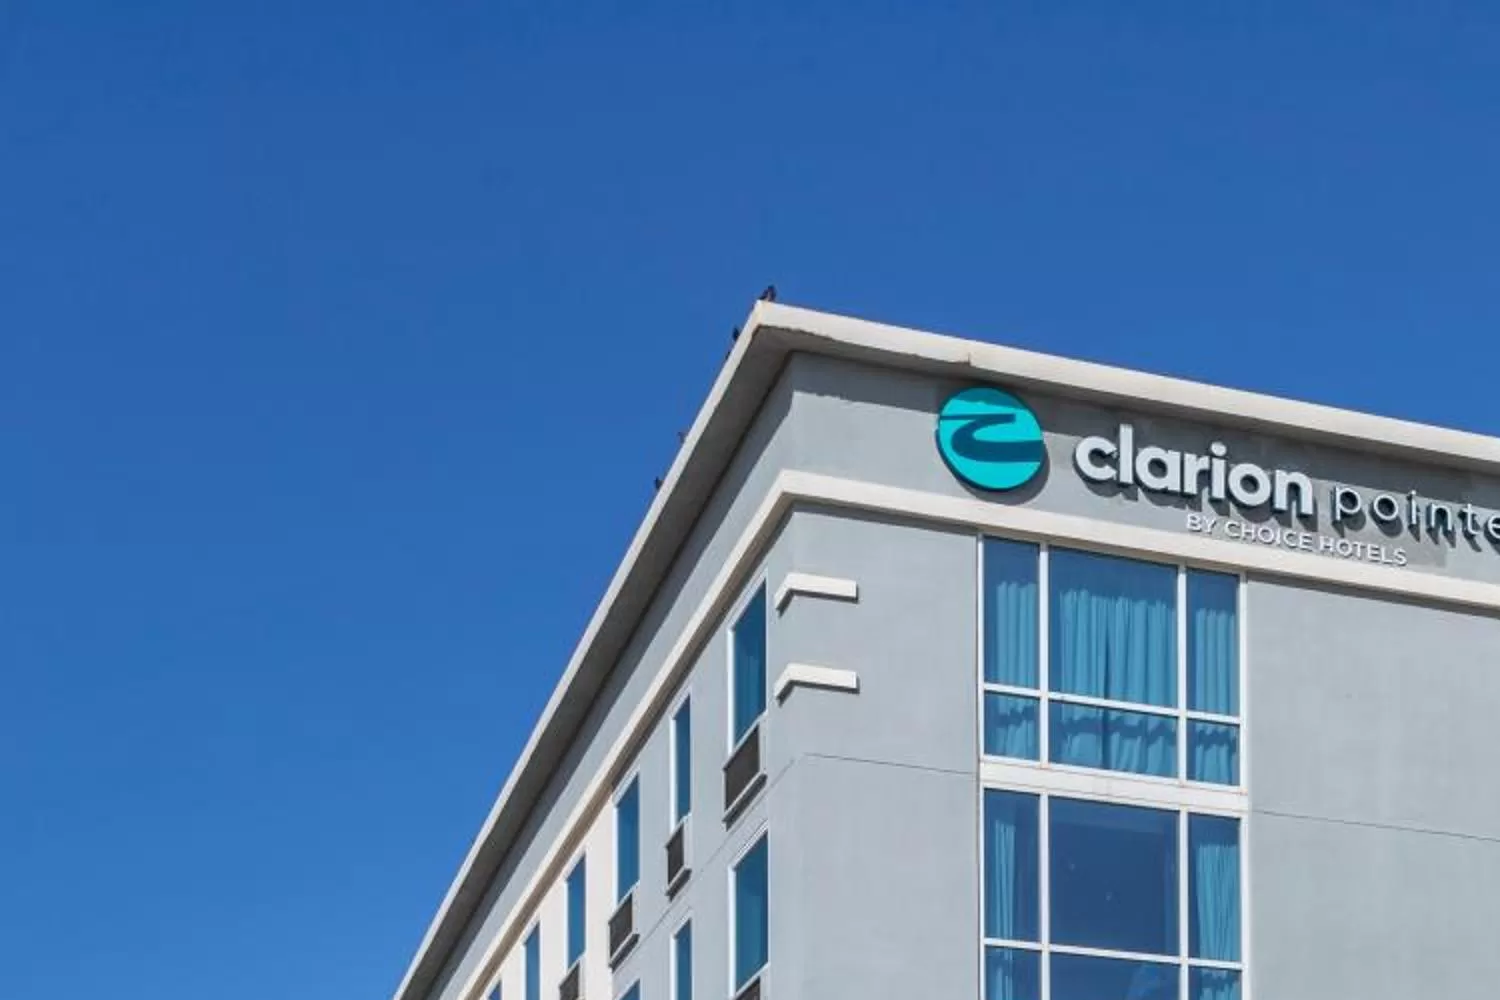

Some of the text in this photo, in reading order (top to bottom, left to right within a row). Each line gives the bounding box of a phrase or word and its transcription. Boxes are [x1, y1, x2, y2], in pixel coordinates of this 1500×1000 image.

[1075, 423, 1314, 515] clarion
[1186, 513, 1408, 567] BY CHOICE HOTELS
